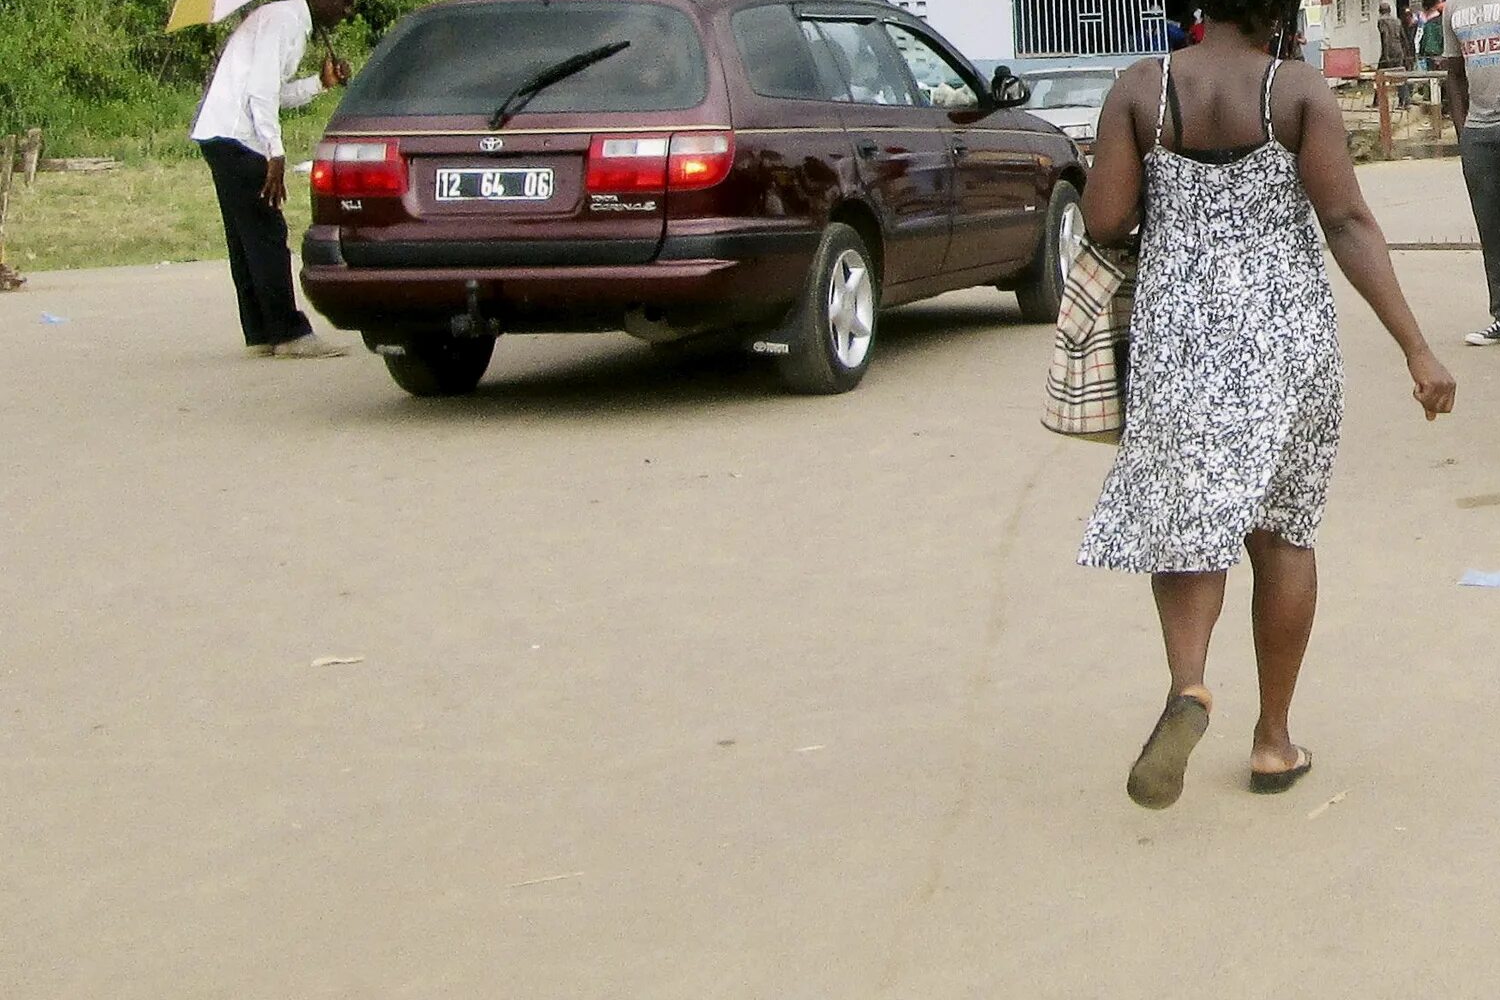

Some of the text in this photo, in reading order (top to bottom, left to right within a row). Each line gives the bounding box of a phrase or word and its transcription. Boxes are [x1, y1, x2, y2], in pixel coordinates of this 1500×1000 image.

[439, 172, 549, 197] 12 64 06
